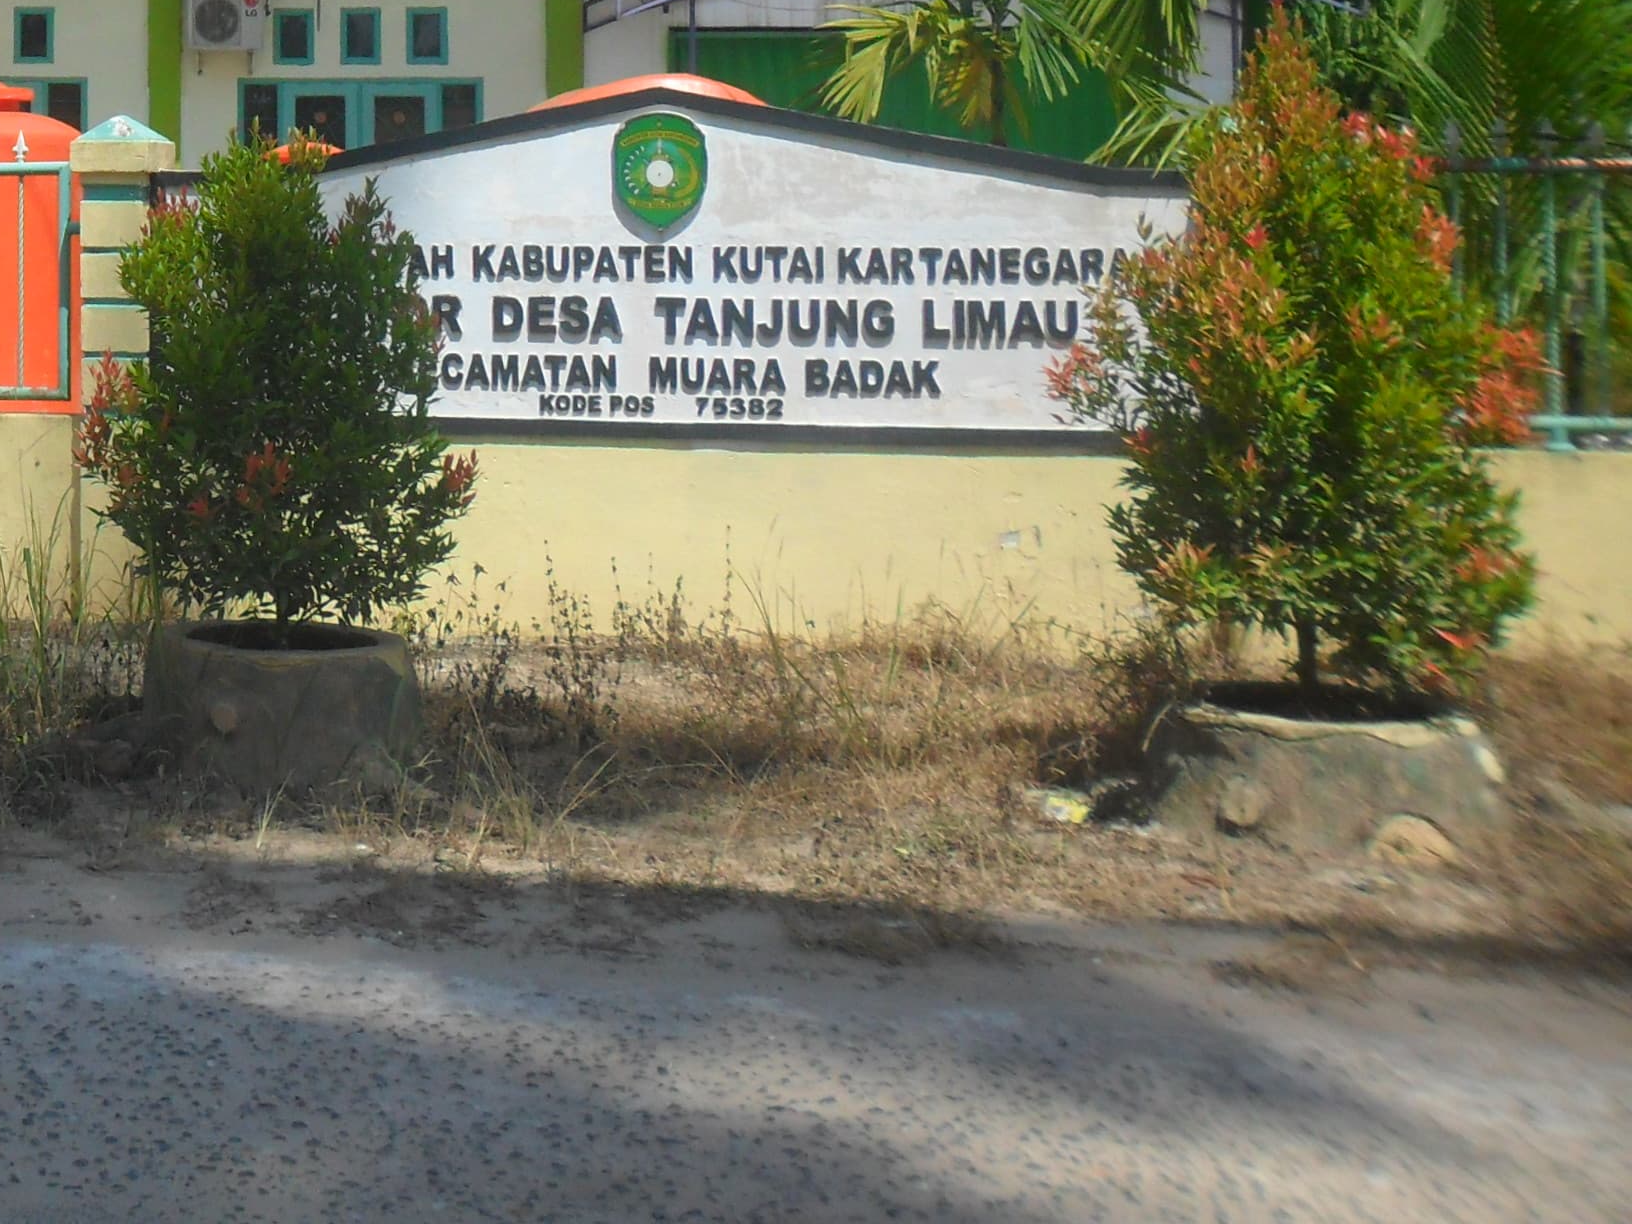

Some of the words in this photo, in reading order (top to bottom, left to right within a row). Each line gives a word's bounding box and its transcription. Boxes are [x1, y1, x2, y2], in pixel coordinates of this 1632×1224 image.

[245, 8, 258, 17] LG
[471, 244, 693, 283] KABUPATEN
[712, 245, 825, 285] KUTAI
[491, 295, 623, 345] DESA
[653, 297, 896, 348] TANJUNG
[921, 298, 1079, 350] LIMAU
[422, 352, 617, 394] CAMATAN
[648, 356, 787, 397] MUARA
[804, 358, 942, 399] BADAK
[538, 393, 603, 416] KODE
[609, 394, 656, 417] POS
[695, 397, 784, 421] 75382
